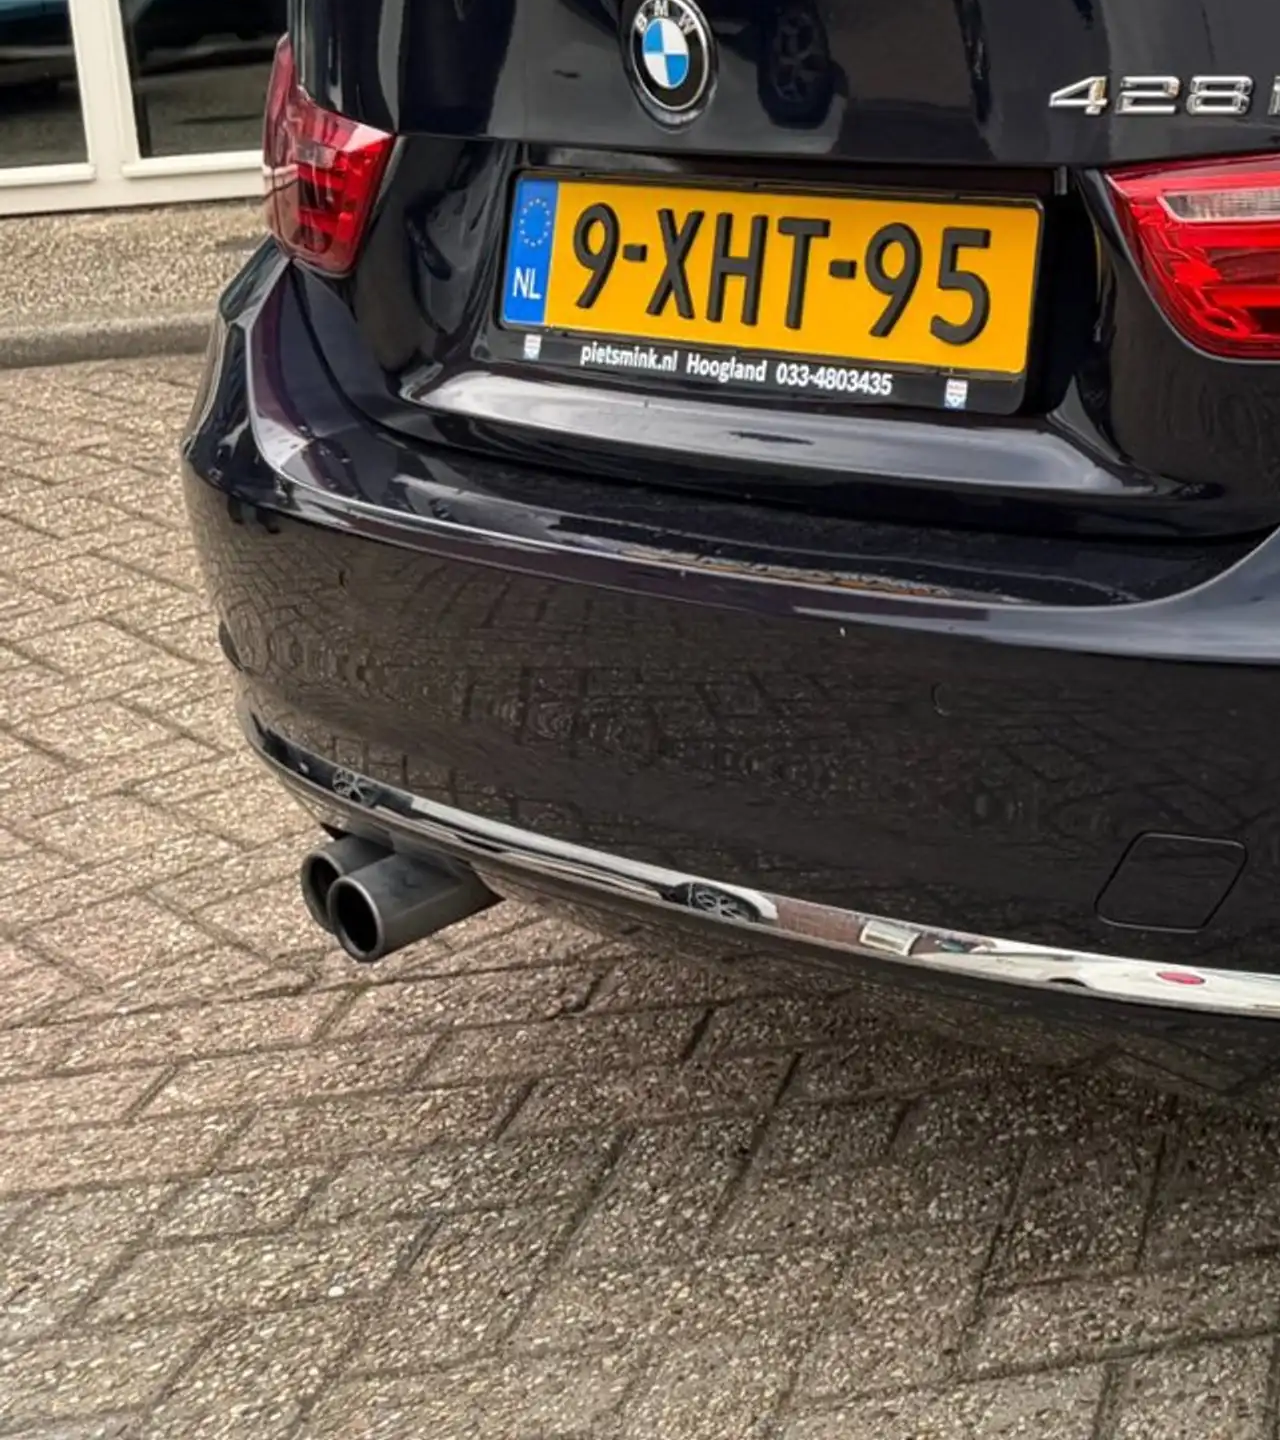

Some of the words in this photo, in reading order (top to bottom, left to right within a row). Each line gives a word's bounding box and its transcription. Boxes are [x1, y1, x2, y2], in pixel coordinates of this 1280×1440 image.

[512, 266, 542, 300] NL
[573, 202, 992, 346] 9-XHT-95
[580, 342, 678, 372] pietsmink.nl
[686, 352, 767, 383] Hoogland
[776, 362, 894, 396] 033-4803435
